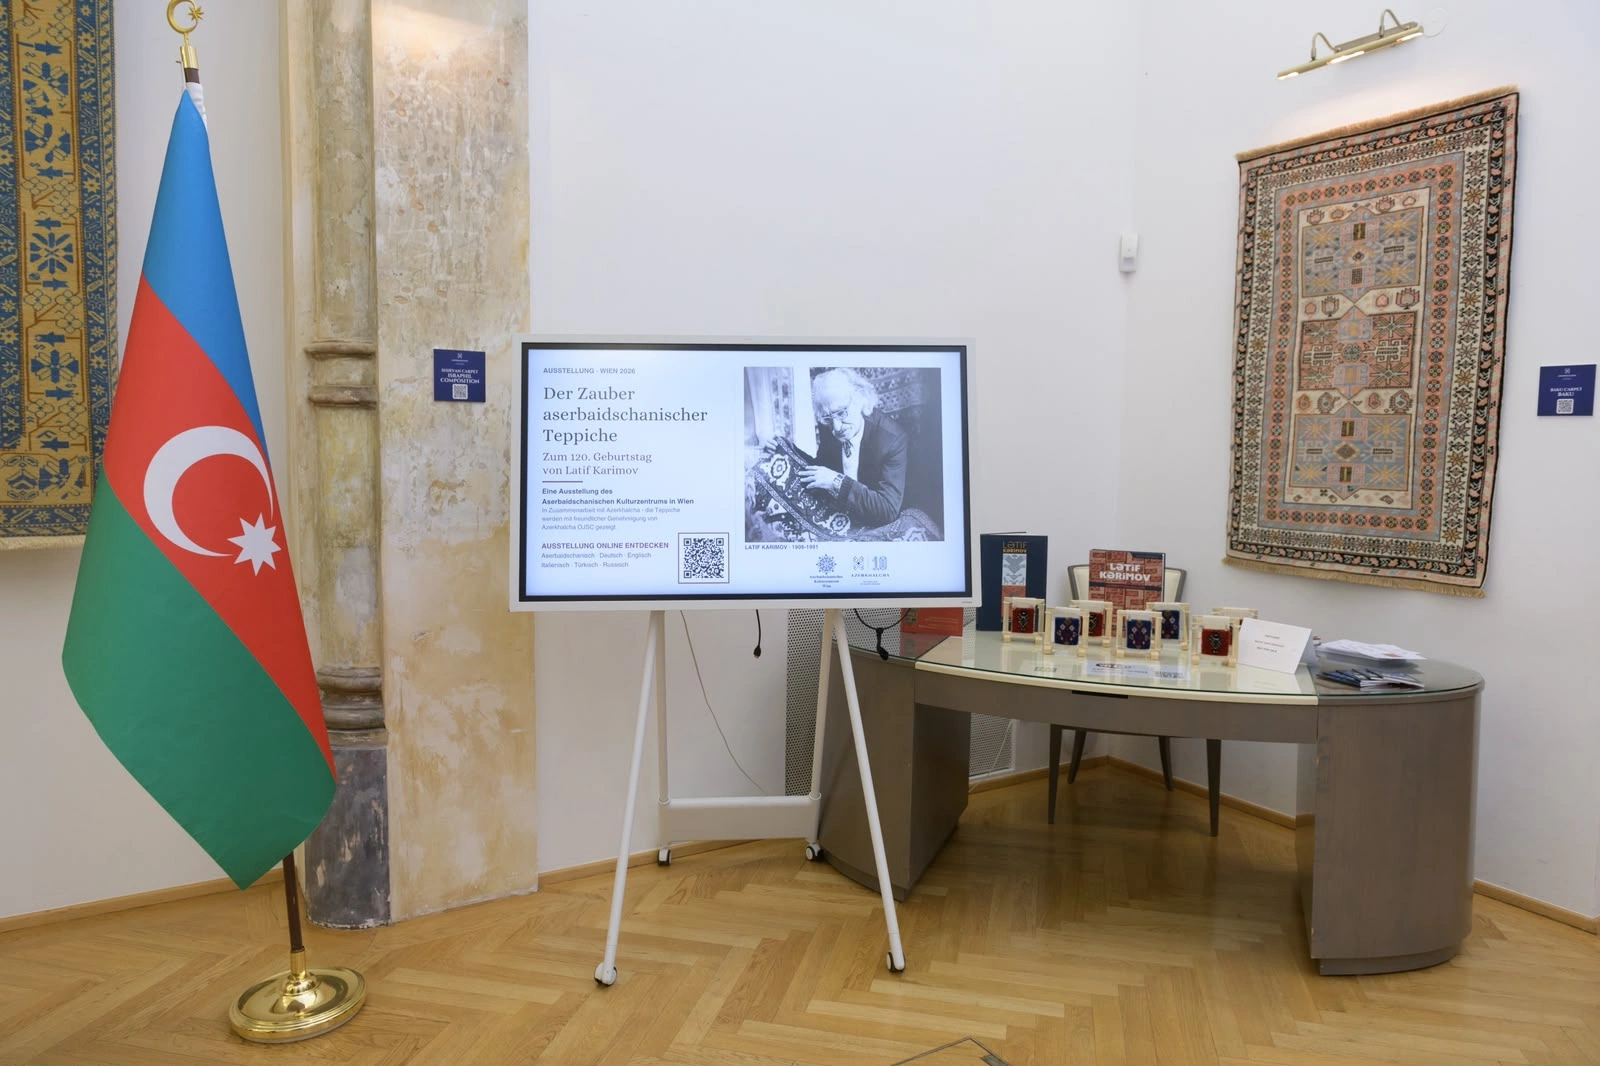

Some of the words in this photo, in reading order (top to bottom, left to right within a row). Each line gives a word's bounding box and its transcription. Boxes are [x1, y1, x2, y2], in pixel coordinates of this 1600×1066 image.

[544, 387, 573, 400] Der
[577, 386, 635, 400] Zauber
[543, 407, 708, 422] aserbaidschanischer
[543, 428, 617, 445] Teppiche
[542, 452, 567, 462] Zum
[571, 453, 590, 462] 120.
[593, 452, 652, 463] Geburtstag
[542, 466, 563, 475] von
[566, 465, 590, 475] Latif
[593, 466, 638, 476] Karimov
